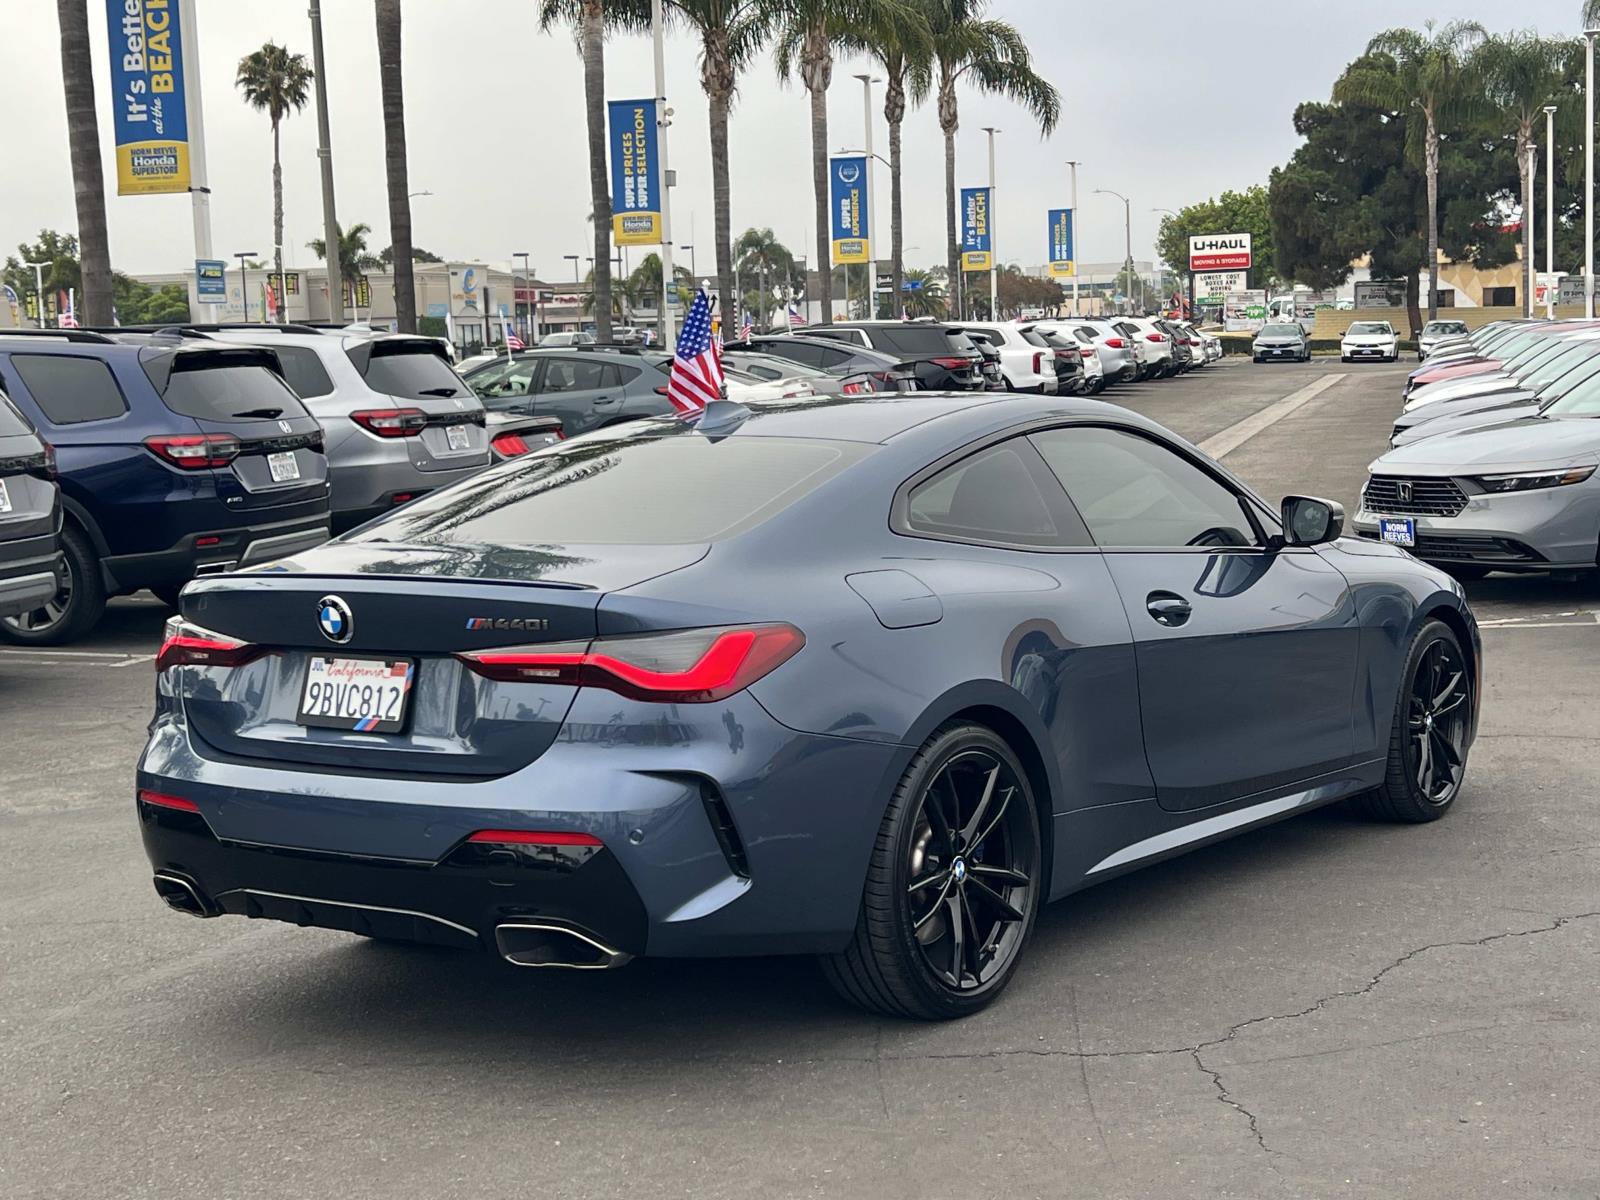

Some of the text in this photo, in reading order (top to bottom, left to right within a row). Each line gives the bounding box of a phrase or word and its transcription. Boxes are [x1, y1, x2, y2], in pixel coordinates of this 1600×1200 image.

[122, 0, 147, 122] It's Bette
[150, 96, 163, 118] the
[152, 119, 164, 135] at
[130, 146, 177, 156] NORM REEVES
[134, 155, 175, 166] Honda
[634, 108, 648, 208] SUPER SELECTION
[132, 166, 178, 176] SUPERSTORE
[622, 132, 635, 208] SUPER PRICES
[841, 198, 851, 229] SUPER
[851, 188, 860, 236] EXPERIENCE
[966, 196, 976, 245] It's Better
[975, 192, 986, 235] BEACH!
[1194, 239, 1247, 250] U-HAUL
[1383, 530, 1411, 542] REEVES
[1385, 522, 1408, 533] NORM
[327, 660, 391, 682] California
[306, 681, 400, 720] 9BVC812
